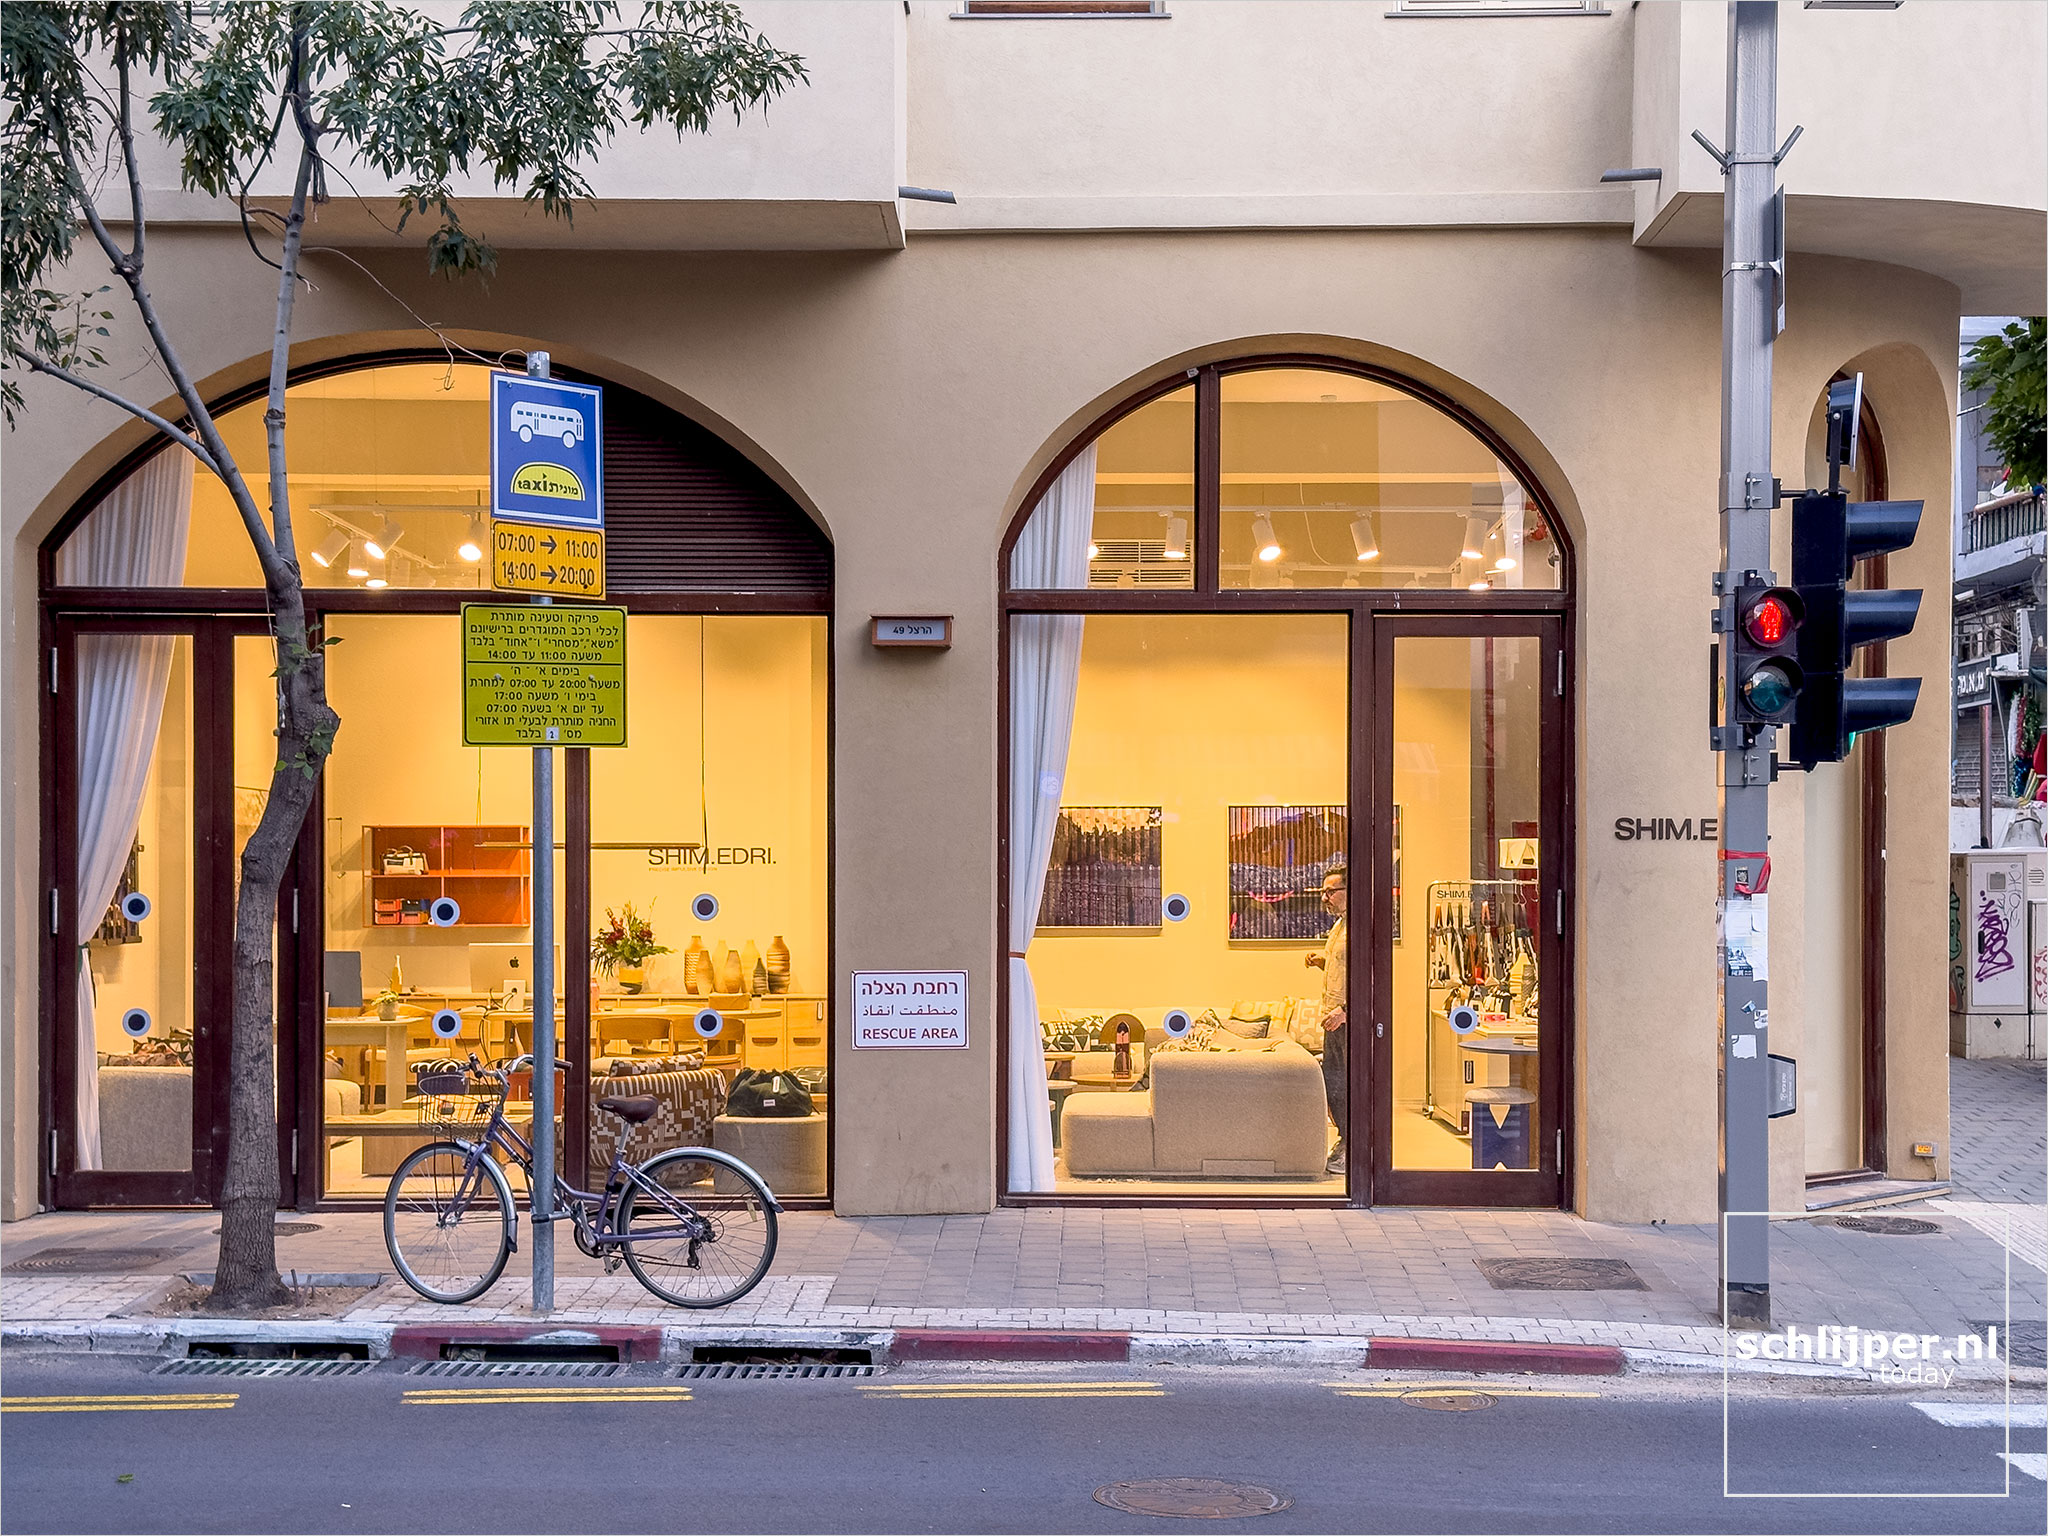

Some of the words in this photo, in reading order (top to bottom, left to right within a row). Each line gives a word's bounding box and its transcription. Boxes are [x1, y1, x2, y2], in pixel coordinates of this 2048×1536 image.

[517, 472, 547, 492] taxi
[548, 481, 579, 495] מונית
[498, 532, 536, 554] 07:00
[565, 540, 598, 560] 11:00
[501, 560, 536, 582] 14:00
[559, 565, 595, 587] 20:00
[490, 611, 525, 622] מותרת
[530, 612, 563, 624] וטעינה
[567, 613, 599, 625] פריקה
[470, 624, 514, 634] ברישיונם
[519, 625, 567, 635] המוגדרים
[571, 627, 591, 636] רכב
[595, 625, 619, 636] לכלי
[892, 626, 905, 635] 49
[907, 624, 932, 635] הרצל
[470, 635, 495, 646] בלבד
[488, 650, 517, 659] 14:00
[522, 651, 536, 661] עד
[540, 651, 567, 660] 11:00
[571, 651, 602, 661] משעה
[551, 666, 580, 676] בימים
[469, 676, 505, 687] למחרת
[510, 678, 537, 688] 07:00
[542, 679, 555, 689] עד
[559, 679, 587, 689] 20:00
[590, 678, 621, 689] משעה
[494, 691, 523, 700] 17:00
[527, 691, 559, 701] משעה
[575, 691, 596, 701] בימי
[486, 703, 517, 713] 07:00
[522, 704, 552, 714] בשעה
[573, 704, 586, 714] יום
[591, 705, 605, 715] עד
[475, 716, 499, 725] אזורי
[503, 716, 515, 725] תו
[519, 715, 547, 726] לבעלי
[551, 717, 584, 726] מותרת
[588, 717, 616, 727] החניה
[515, 727, 542, 738] בלבד
[549, 730, 554, 739] 2
[648, 847, 777, 866] SHIM.EDRI.
[862, 980, 907, 995] הצלה
[912, 981, 958, 995] רחבת
[863, 1028, 916, 1039] RESCUE
[921, 1028, 959, 1039] AREA
